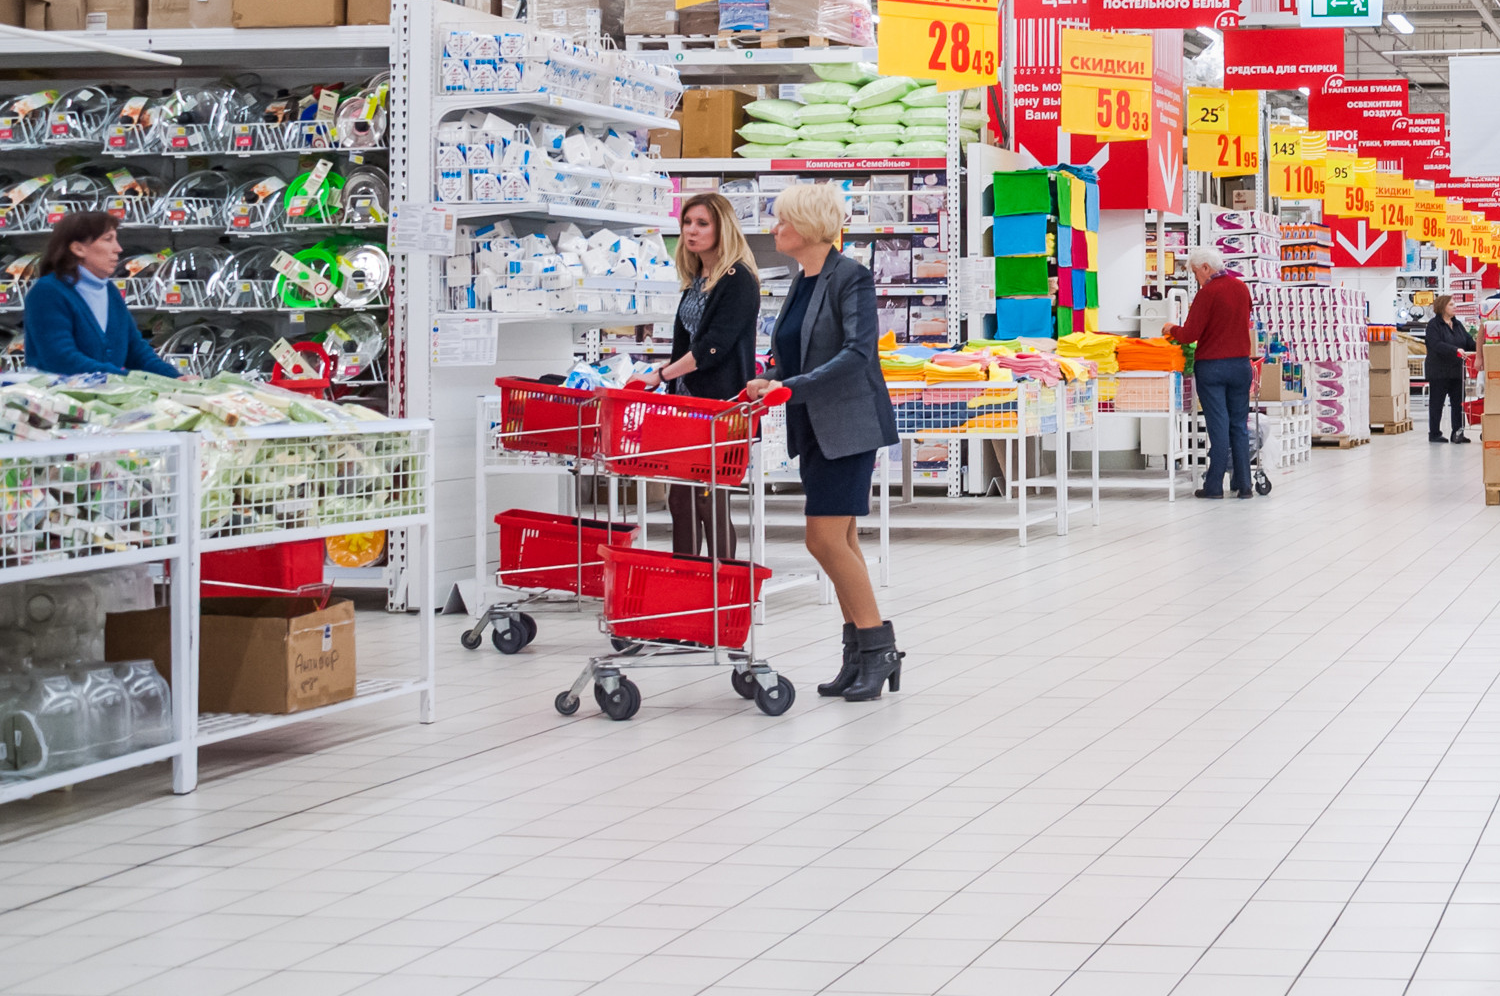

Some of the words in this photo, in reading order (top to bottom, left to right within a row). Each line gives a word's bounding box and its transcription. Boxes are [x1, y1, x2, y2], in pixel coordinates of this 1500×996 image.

[1219, 17, 1236, 27] 51
[1070, 56, 1145, 75] СКИДКИ!
[1226, 65, 1273, 75] СРЕДСТВА
[1276, 64, 1298, 75] ДЛЯ
[1300, 63, 1338, 74] СТИРКИ
[1329, 79, 1342, 87] 49
[1025, 110, 1058, 120] Вами
[1363, 110, 1402, 118] ВОЗДУХА
[805, 160, 855, 168] Комплекты
[856, 159, 911, 168] «Семейные»
